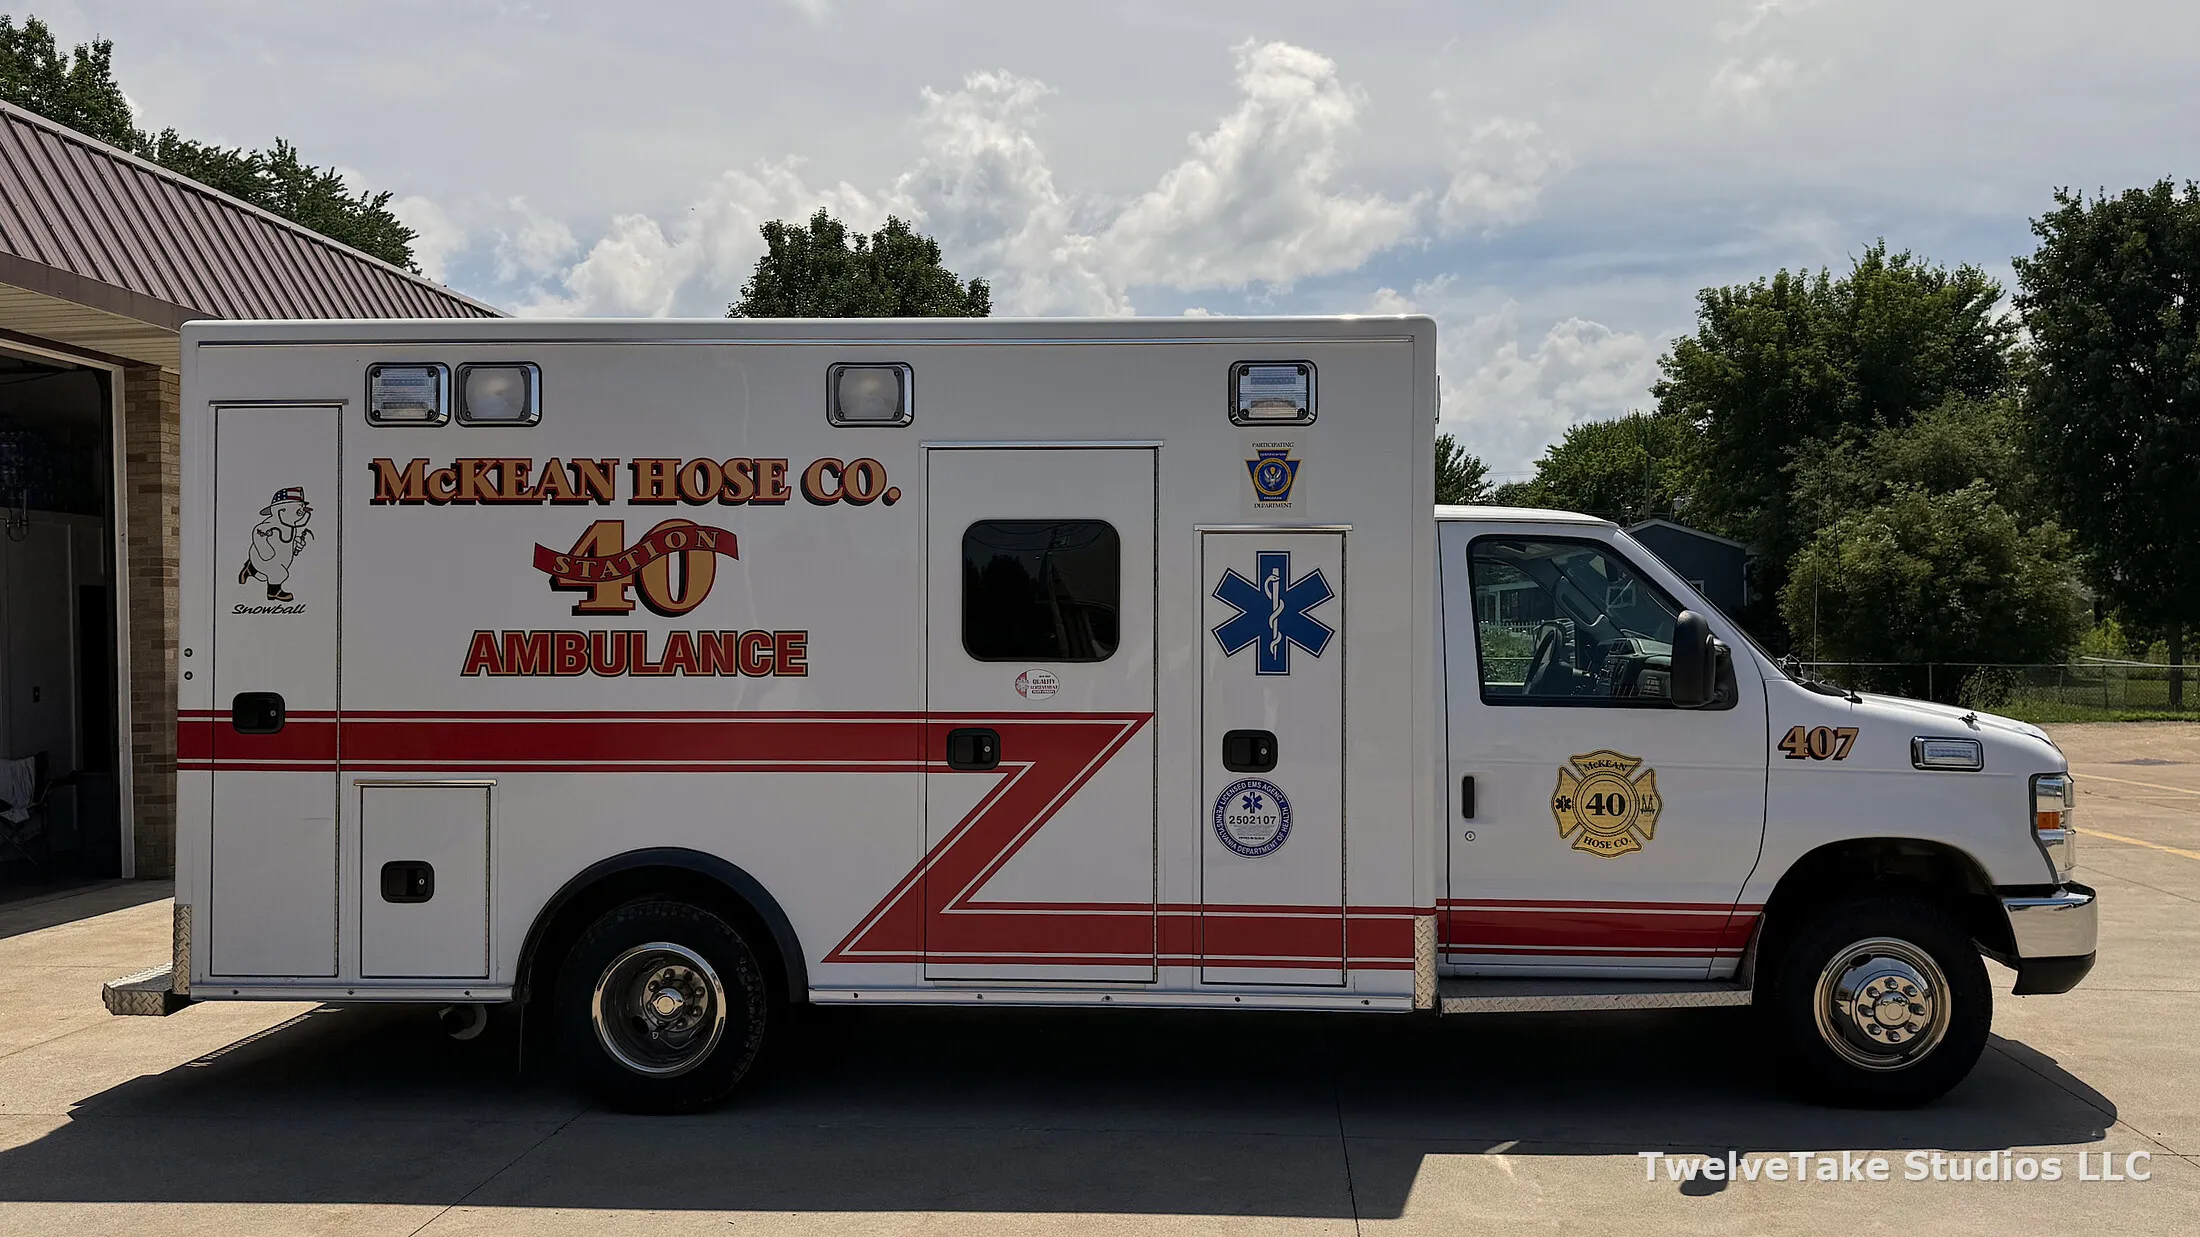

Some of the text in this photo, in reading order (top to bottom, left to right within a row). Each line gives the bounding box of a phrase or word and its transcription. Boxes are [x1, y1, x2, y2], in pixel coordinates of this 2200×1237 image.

[369, 457, 902, 507] McKEAN HOSE CO.
[549, 518, 718, 617] 40
[553, 529, 720, 579] STATION
[231, 603, 306, 615] Snowball
[460, 630, 808, 677] AMBULANCE
[1777, 725, 1860, 761] 407
[1583, 759, 1628, 772] McKEAN
[1219, 781, 1286, 805] LICENSED EMS AGENCY
[1585, 793, 1626, 817] 40
[1215, 805, 1237, 850] PENNSYLVANIA
[1236, 839, 1279, 855] DEPARTMENT
[1276, 831, 1285, 841] OF
[1281, 806, 1290, 833] HEALTH
[1229, 815, 1277, 825] 2502107
[1583, 836, 1632, 849] HOSE CO.
